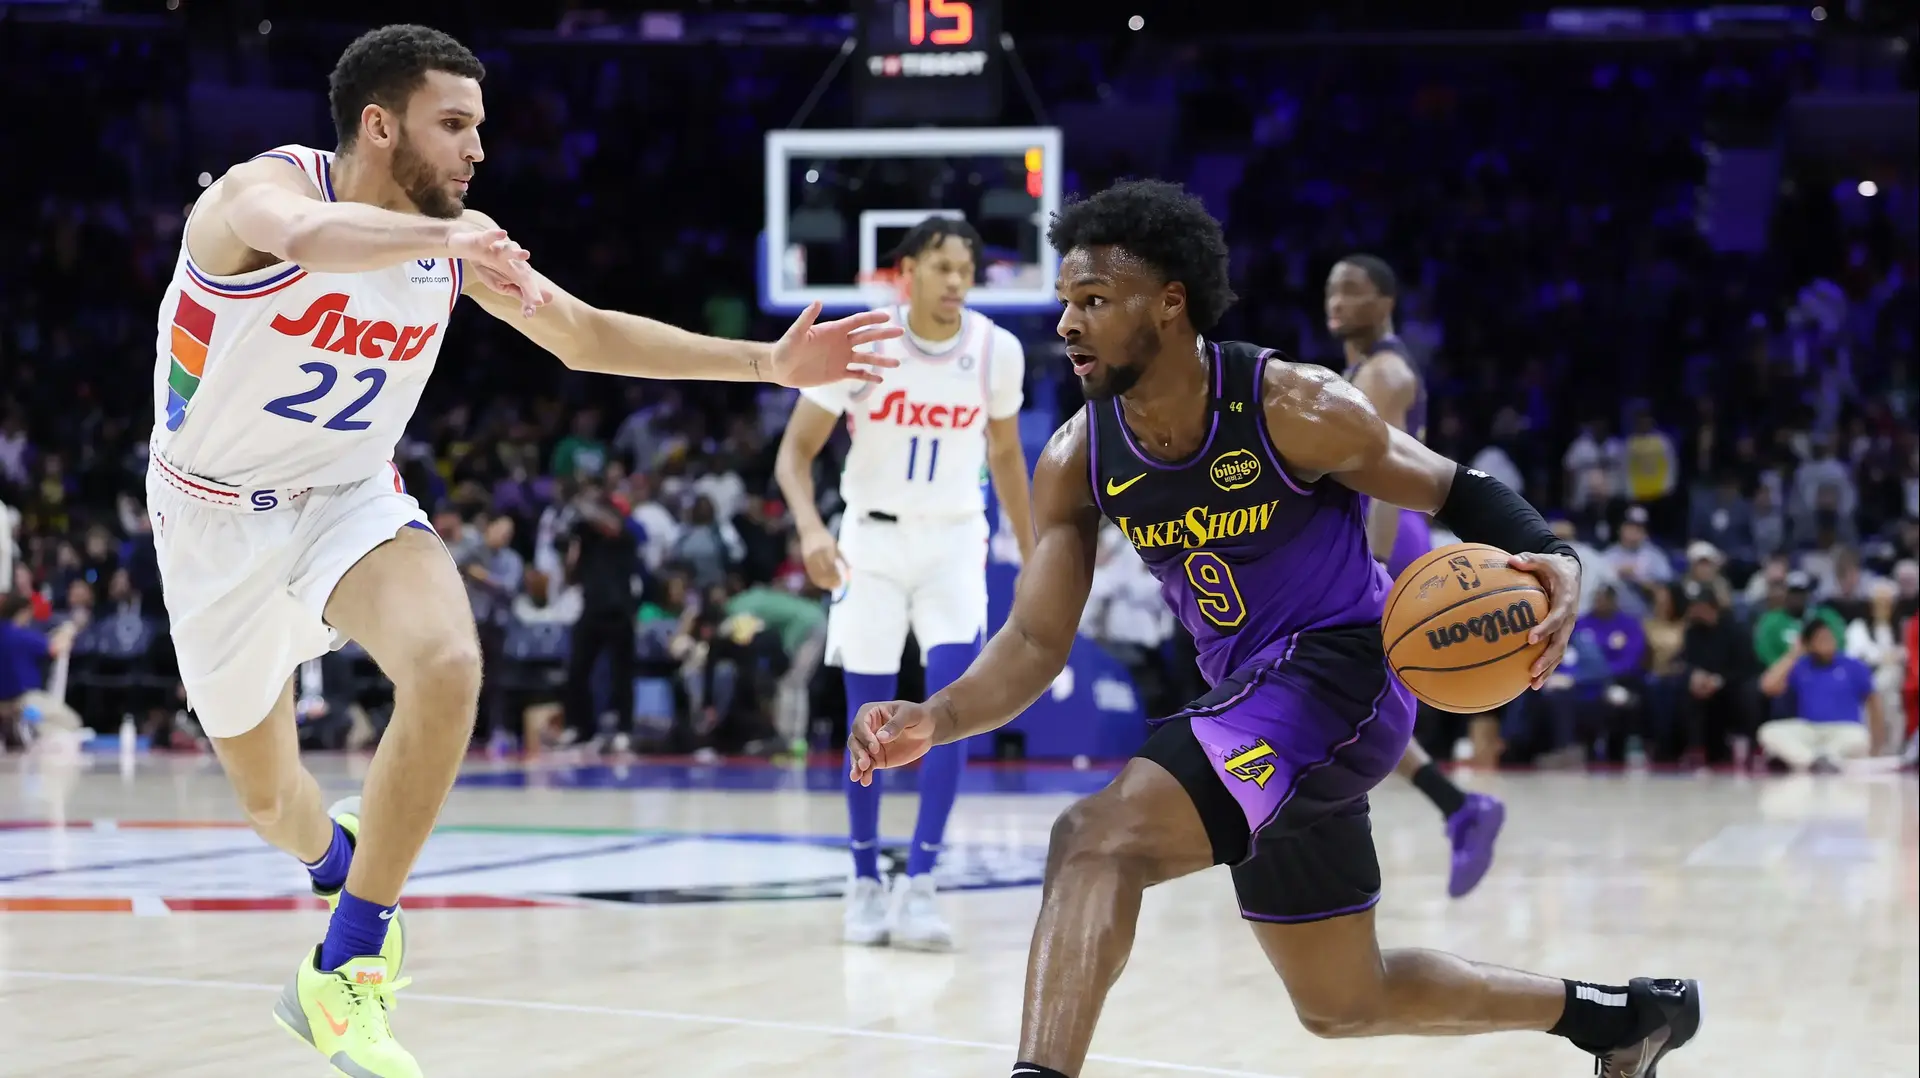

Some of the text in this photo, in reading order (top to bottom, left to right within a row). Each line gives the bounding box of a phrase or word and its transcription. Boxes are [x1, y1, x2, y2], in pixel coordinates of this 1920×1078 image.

[909, 0, 973, 45] 15
[411, 276, 449, 284] crypto.com
[270, 292, 439, 361] Sixers
[263, 362, 387, 431] 22
[869, 390, 980, 429] Sixers
[1229, 401, 1244, 413] 44
[906, 435, 940, 482] 11
[1213, 460, 1258, 479] bibigo
[1184, 552, 1247, 626] 9
[1426, 599, 1539, 650] Wilson
